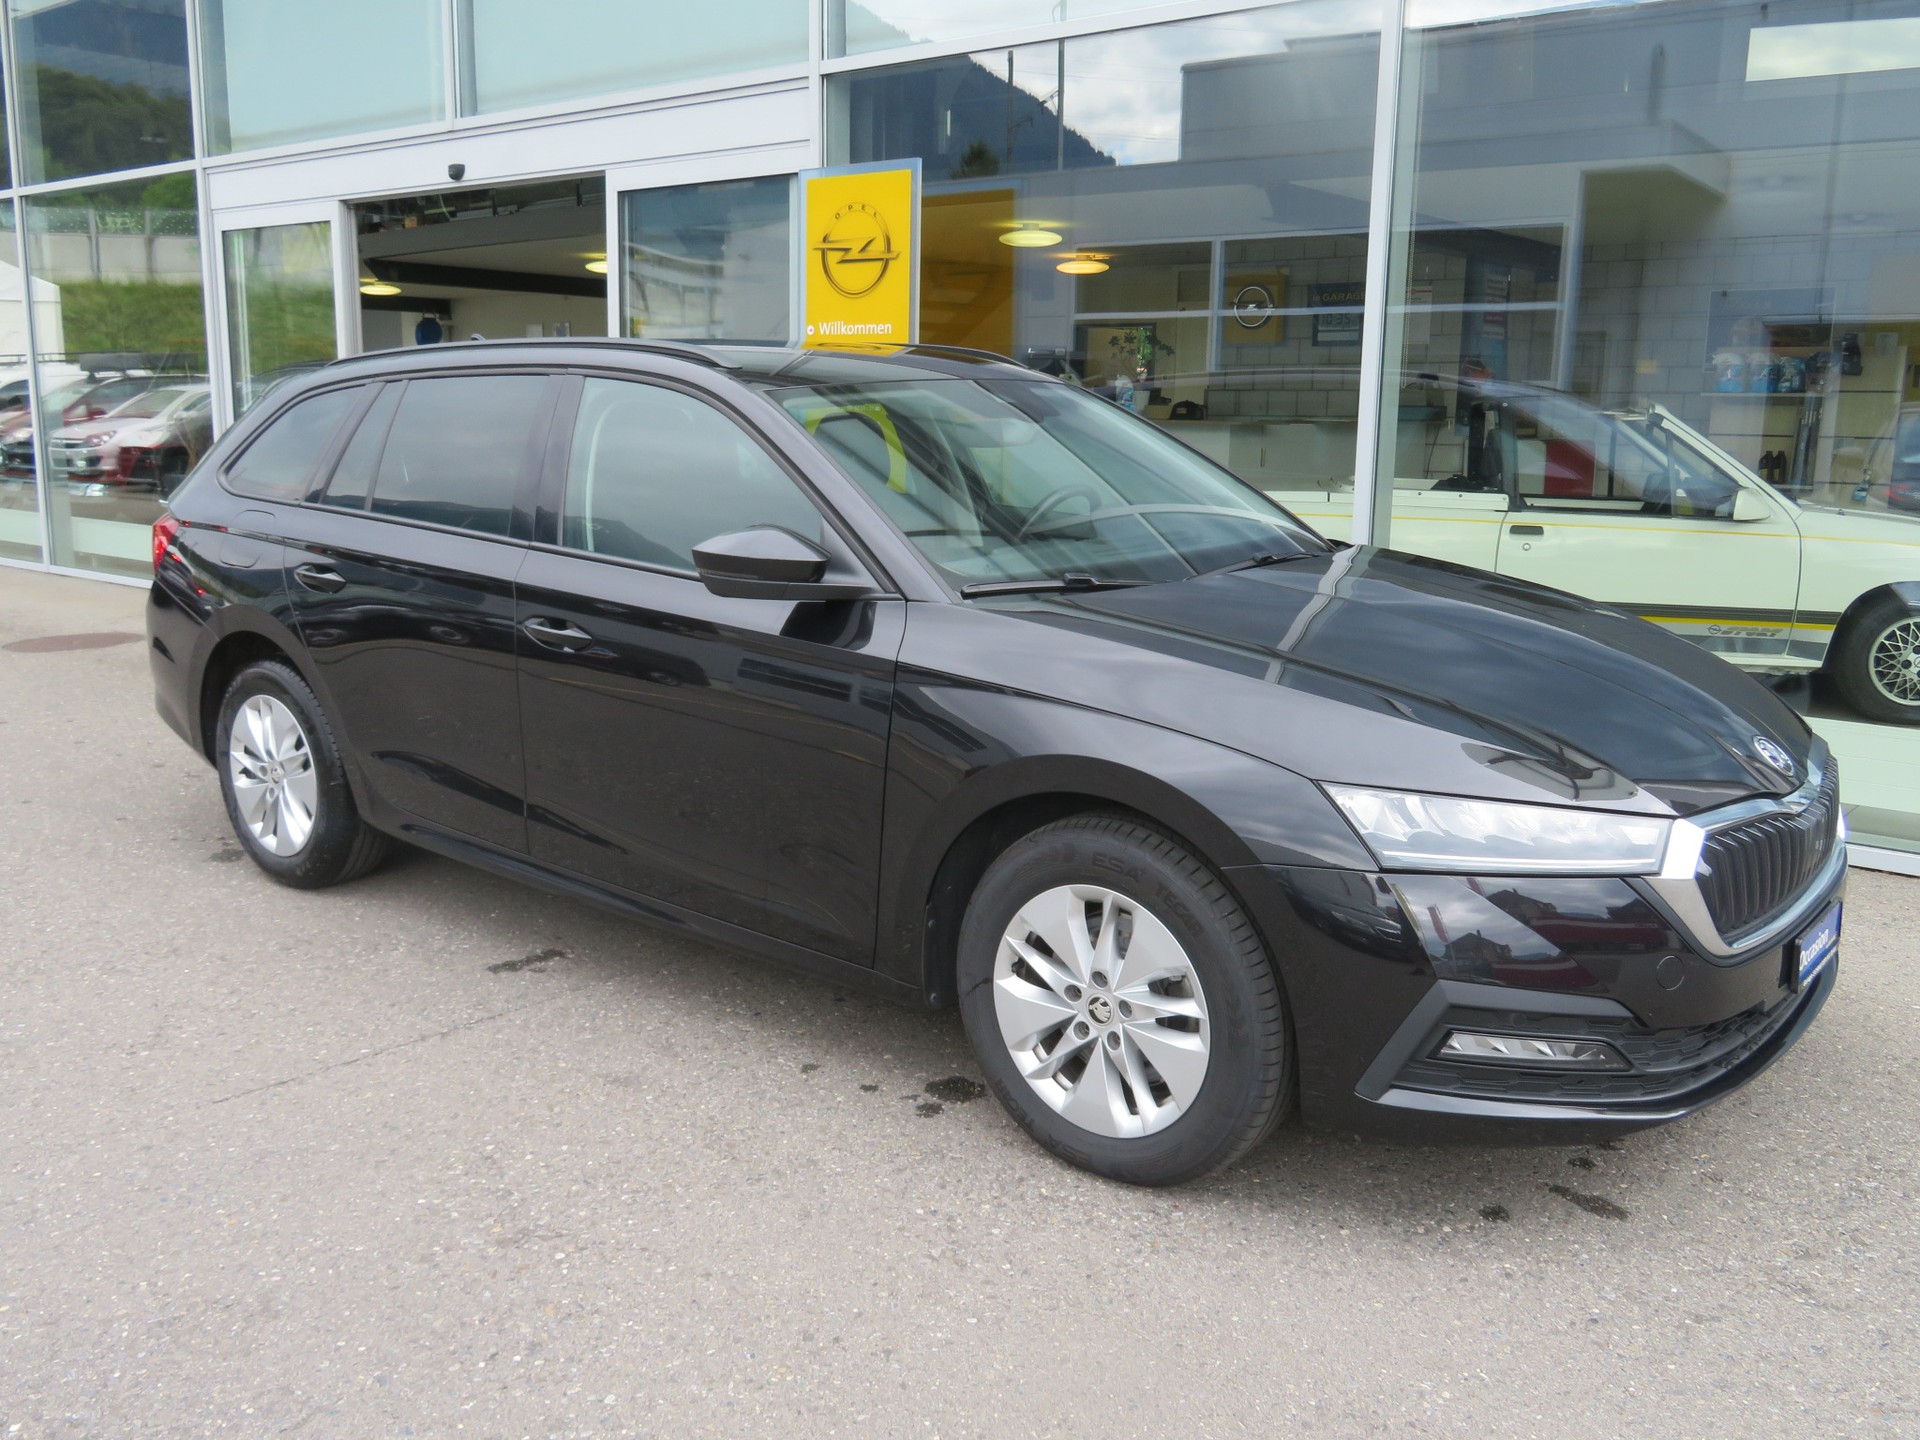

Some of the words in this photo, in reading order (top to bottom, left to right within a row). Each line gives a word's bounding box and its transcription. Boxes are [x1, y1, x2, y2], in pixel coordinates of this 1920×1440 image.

[834, 204, 878, 220] OPEL
[819, 320, 892, 336] Willkommen
[1799, 928, 1829, 971] Occasion
